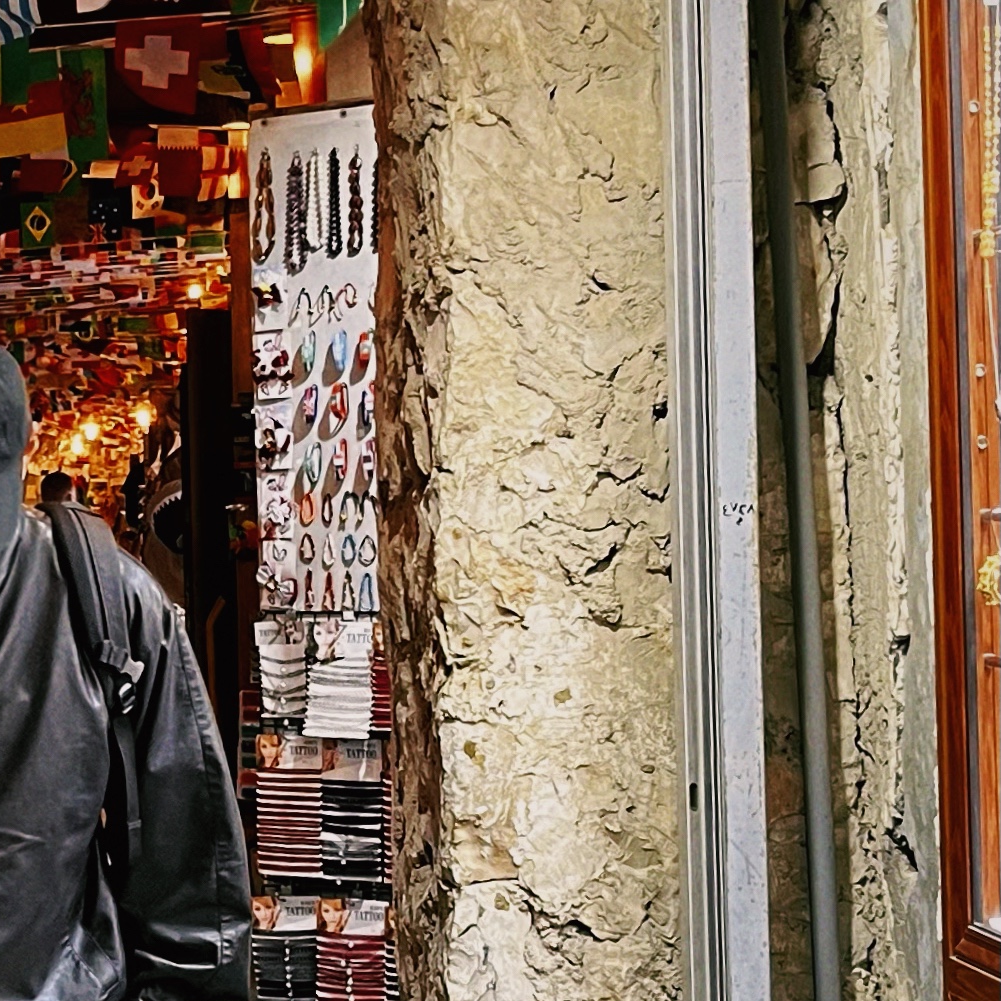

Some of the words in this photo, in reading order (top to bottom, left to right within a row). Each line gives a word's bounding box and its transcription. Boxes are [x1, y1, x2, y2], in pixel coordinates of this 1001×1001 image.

[290, 745, 318, 755] TATTOO
[285, 906, 316, 916] TATTOO
[354, 911, 384, 921] TATTOO
